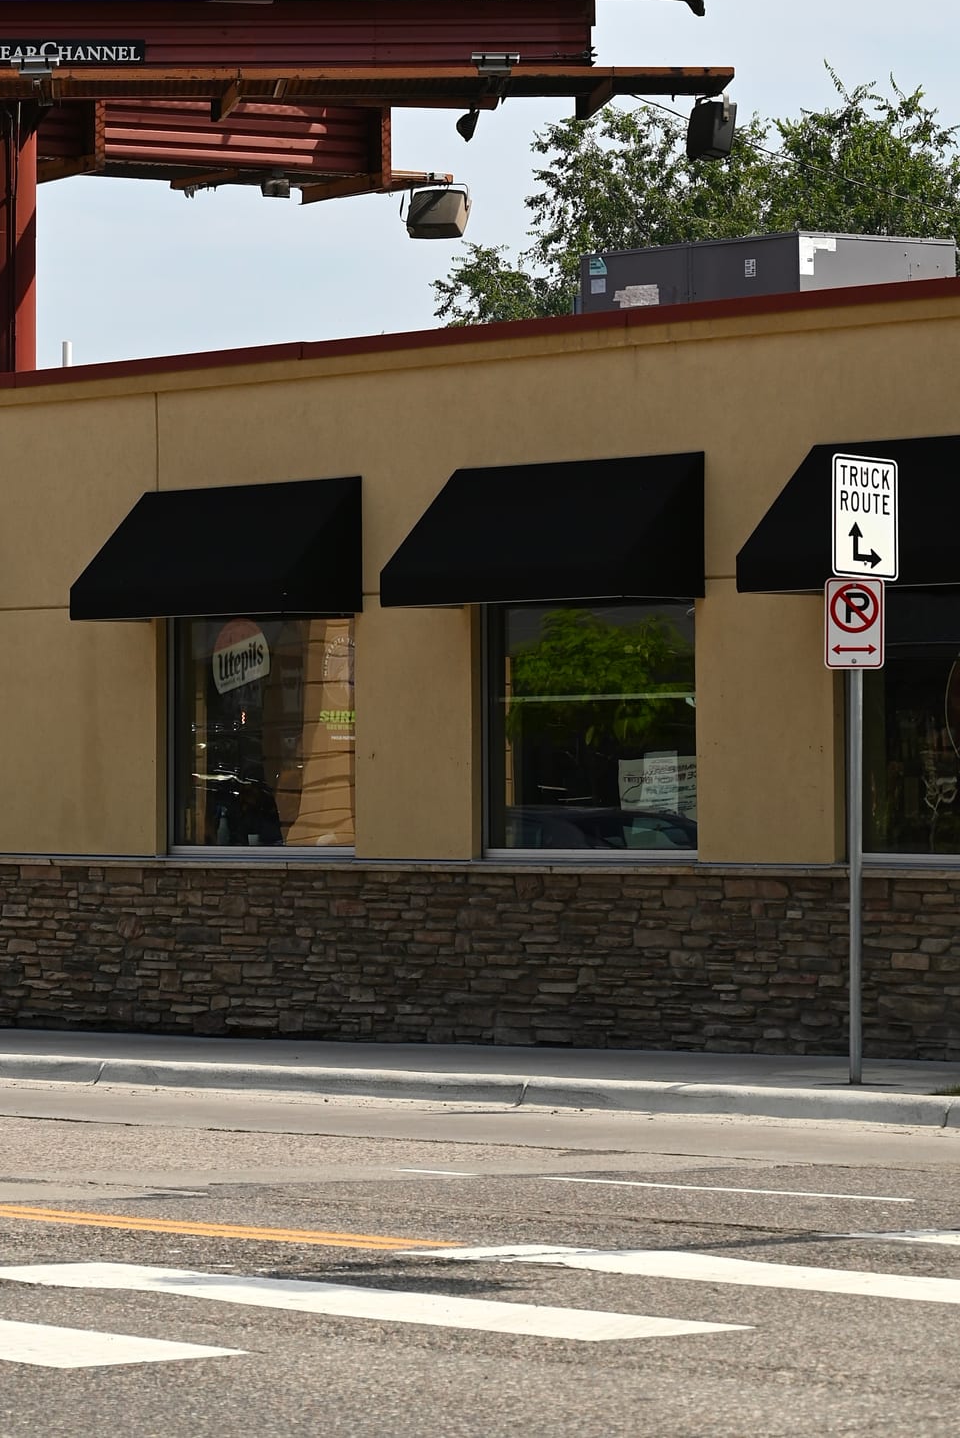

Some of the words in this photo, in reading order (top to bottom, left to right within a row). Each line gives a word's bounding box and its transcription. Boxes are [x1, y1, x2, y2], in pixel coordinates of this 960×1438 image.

[839, 464, 891, 492] TRUCK
[840, 489, 891, 517] ROUTE
[218, 642, 264, 681] Utepils
